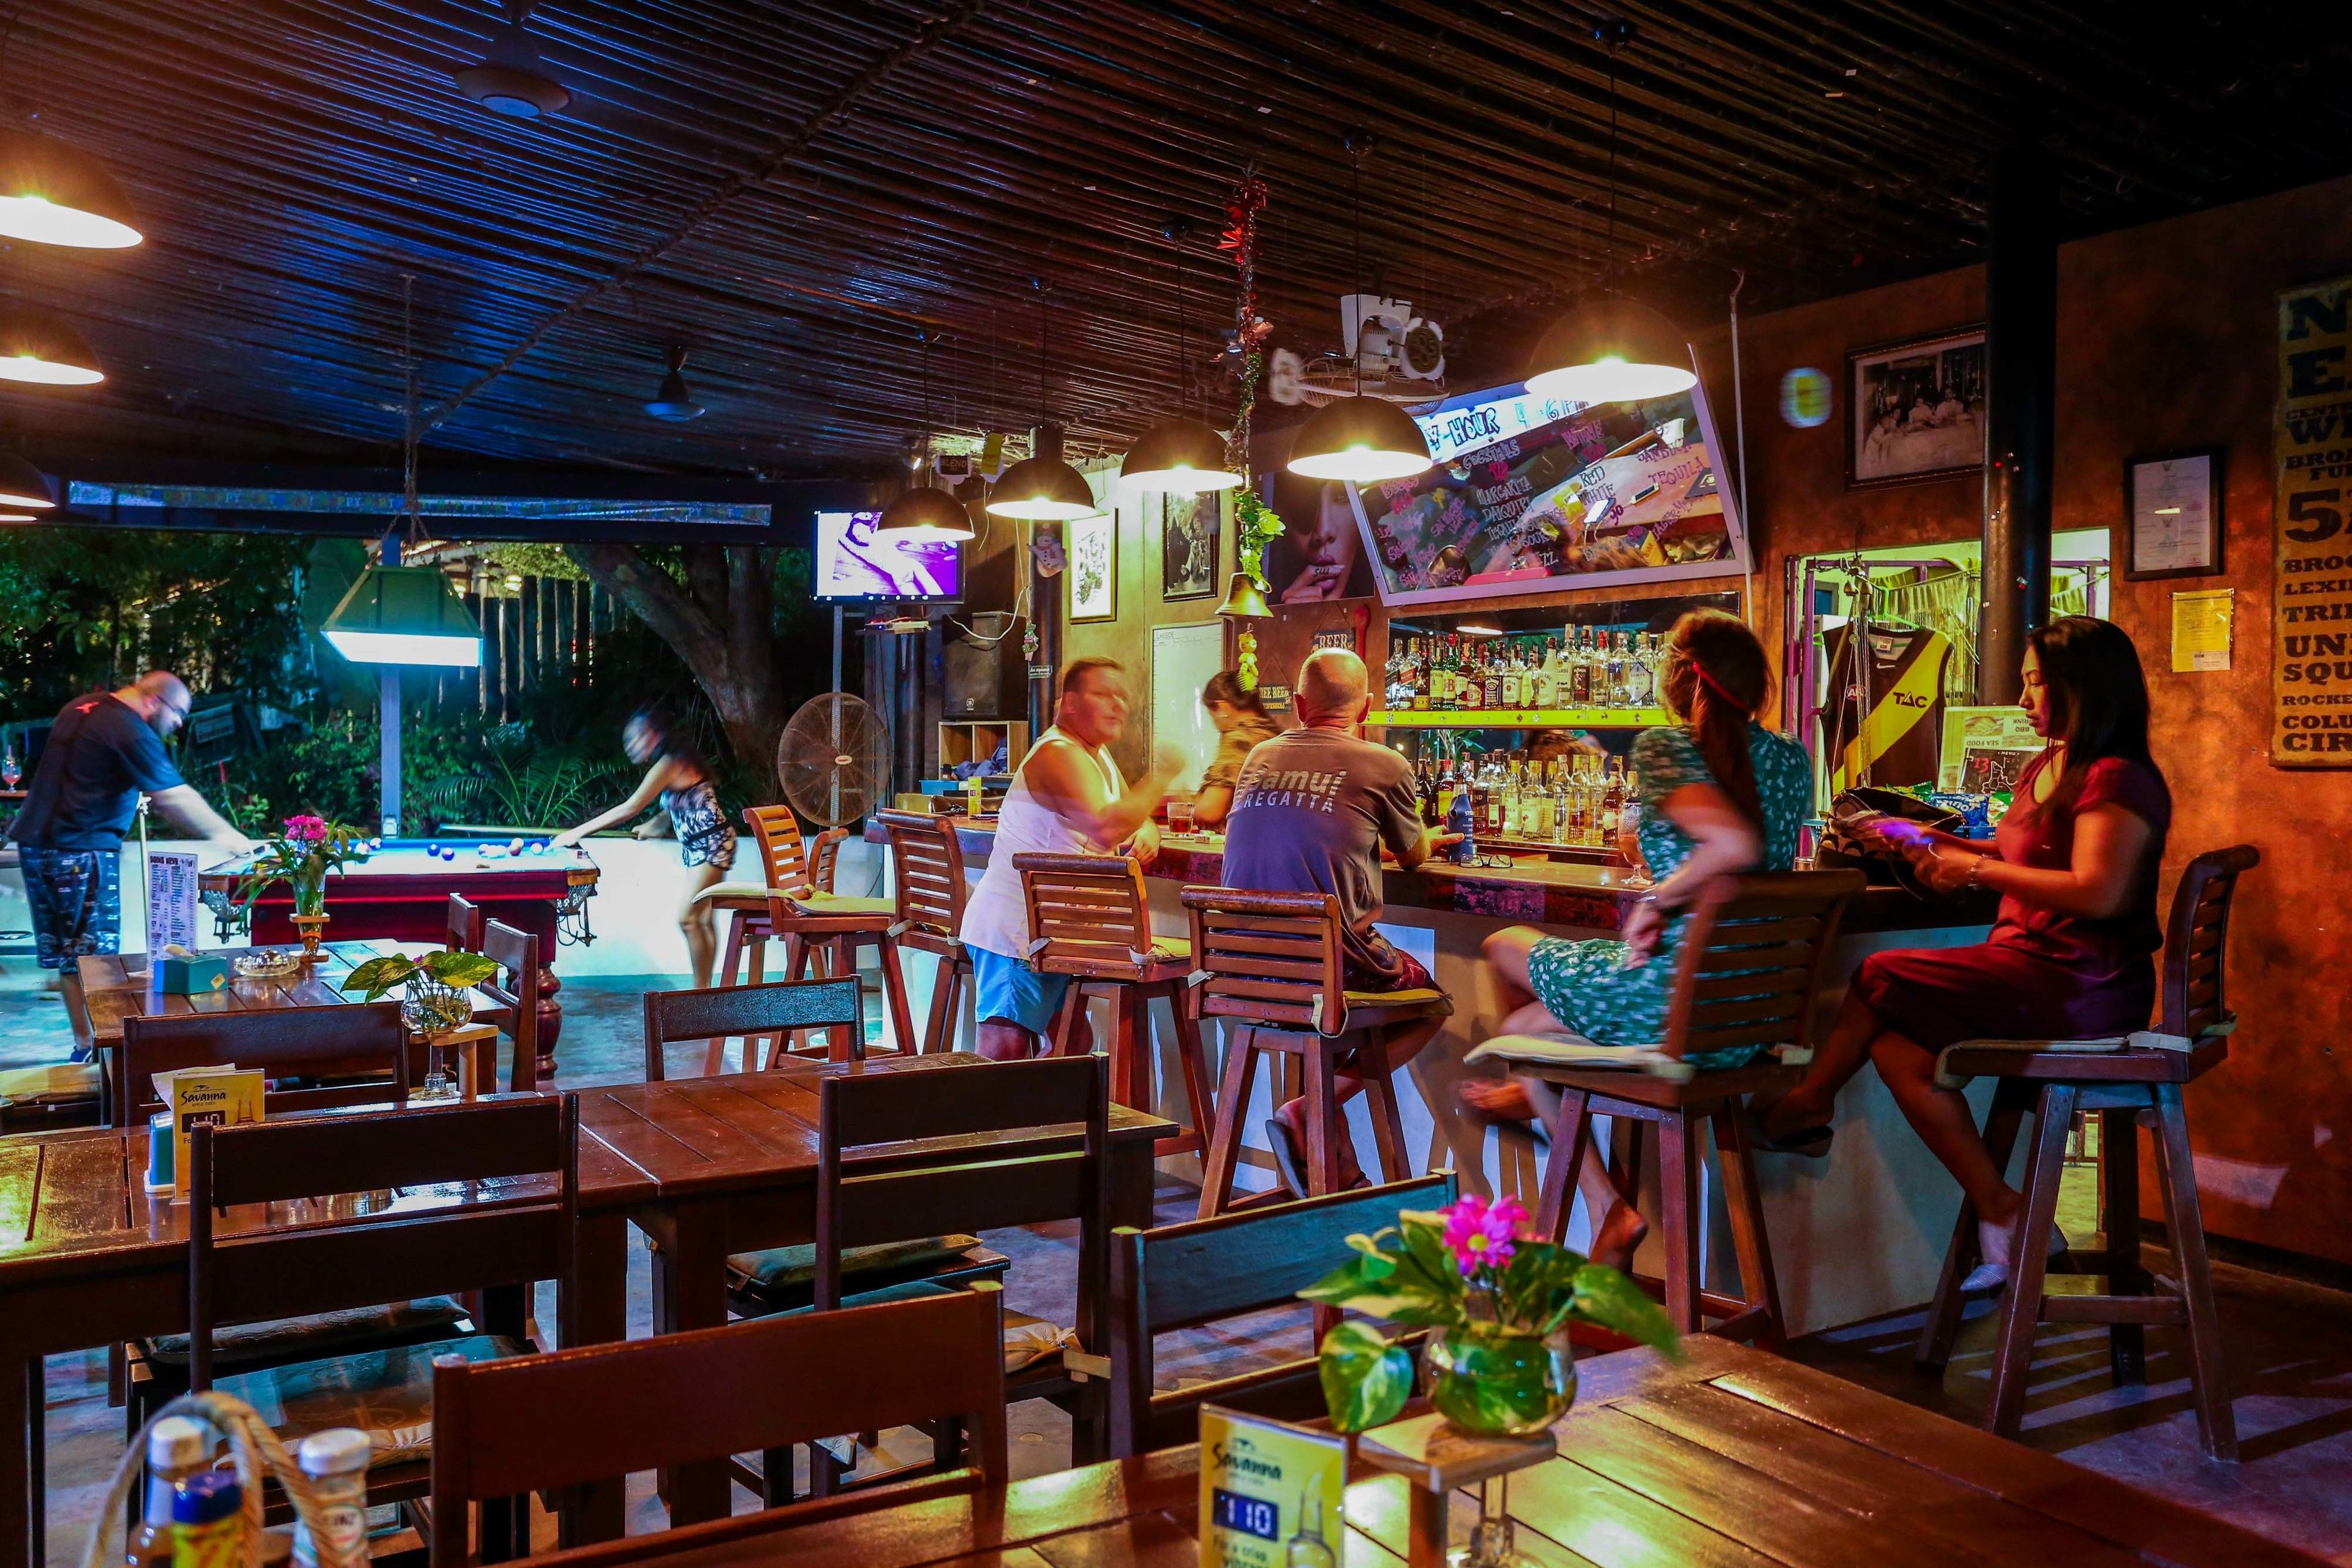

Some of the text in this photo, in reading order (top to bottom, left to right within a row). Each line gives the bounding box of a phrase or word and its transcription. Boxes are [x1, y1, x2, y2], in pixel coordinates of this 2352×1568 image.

[1580, 466, 1605, 488] RED
[1319, 634, 1349, 649] BEER
[1893, 691, 1929, 709] TAC
[1973, 757, 1990, 773] 13
[1243, 791, 1335, 814] REGATTA
[181, 1091, 225, 1107] Savanna
[1212, 1443, 1281, 1480] Savanna
